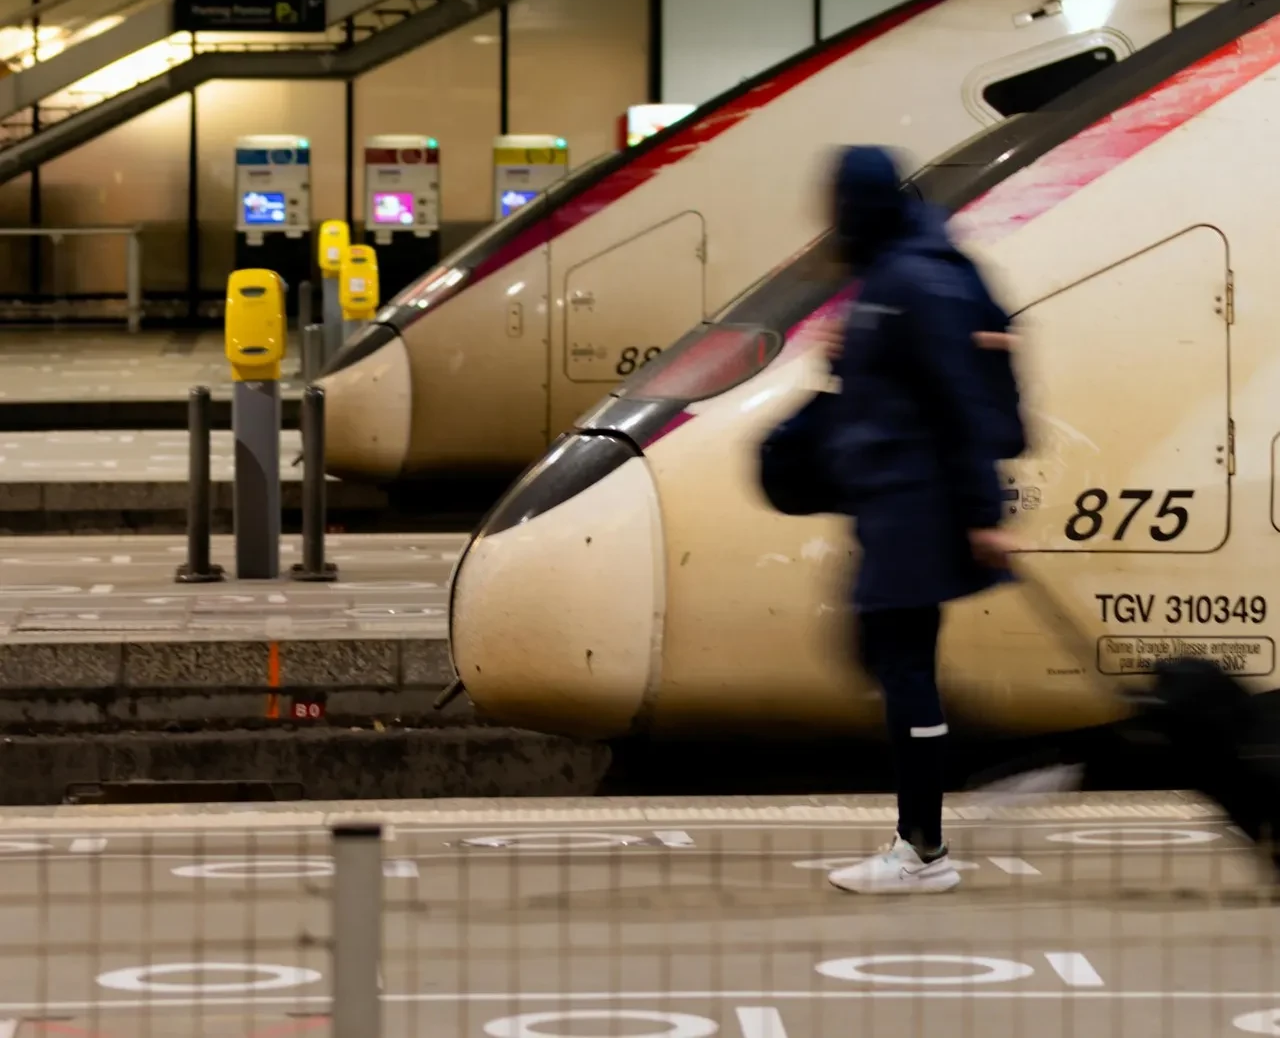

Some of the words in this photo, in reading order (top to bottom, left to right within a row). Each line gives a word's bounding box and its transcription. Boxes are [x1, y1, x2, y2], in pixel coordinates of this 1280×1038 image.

[1064, 488, 1195, 542] 875
[1095, 593, 1155, 623] TGV
[1165, 595, 1267, 624] 310349
